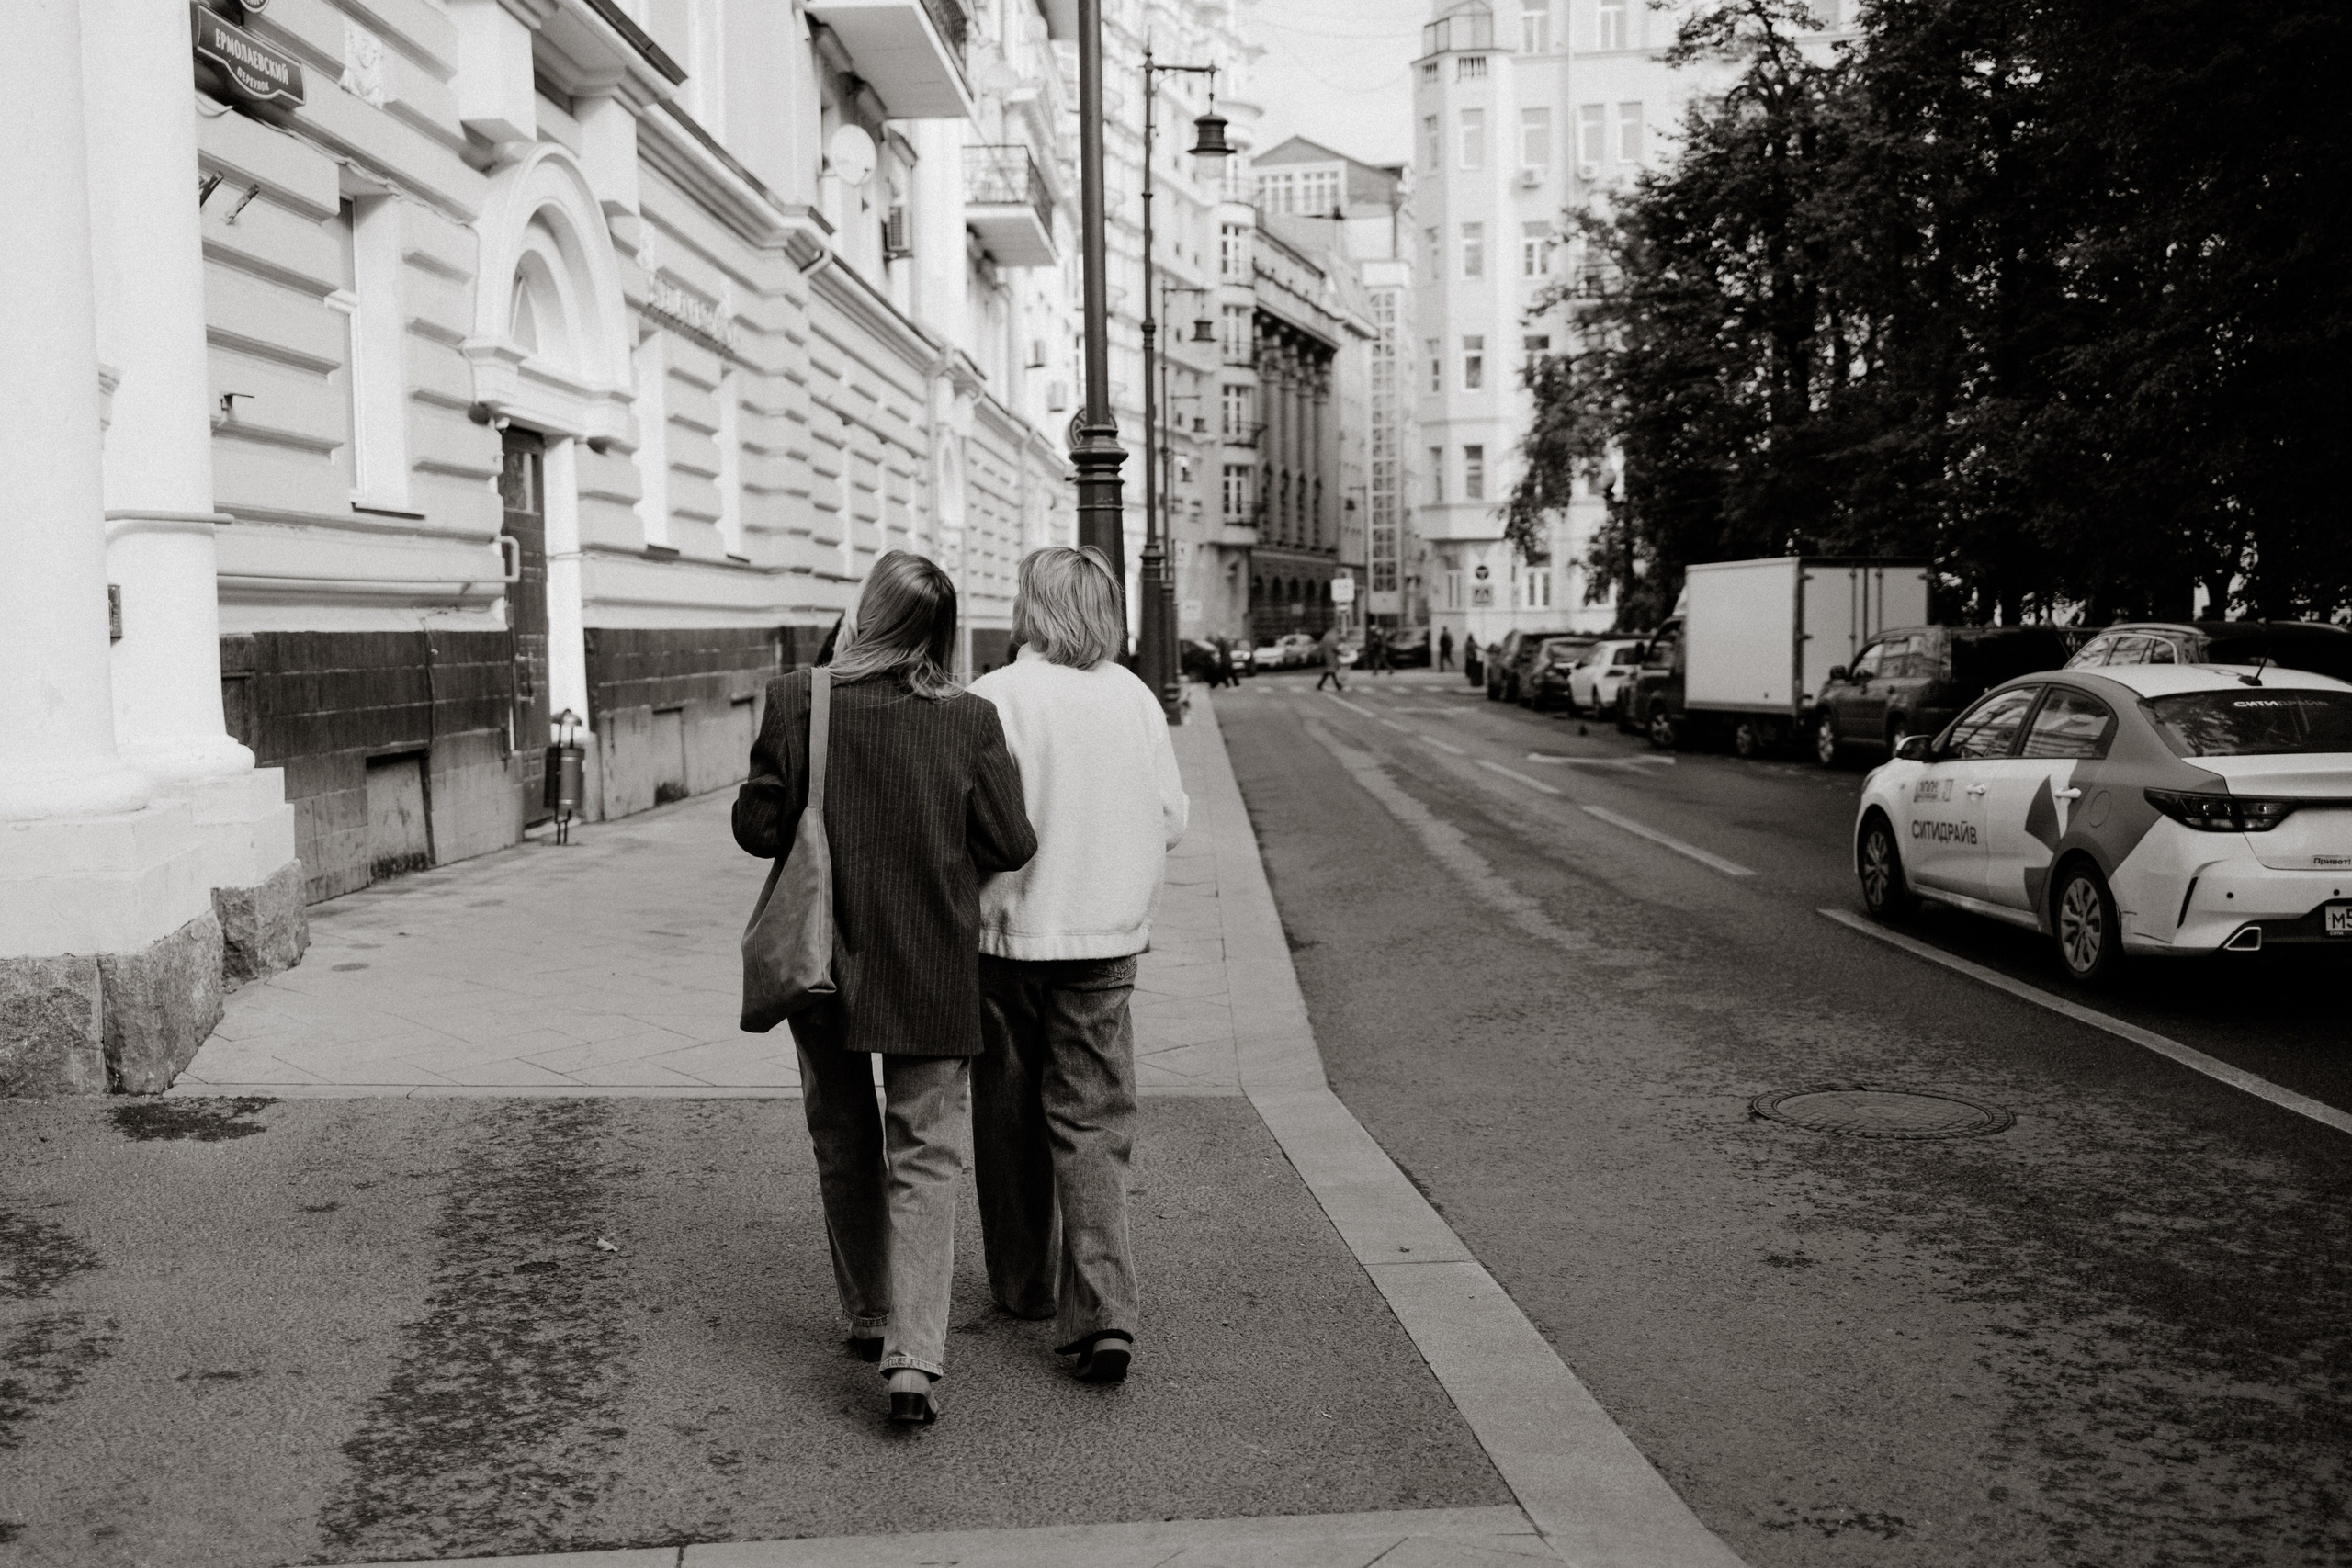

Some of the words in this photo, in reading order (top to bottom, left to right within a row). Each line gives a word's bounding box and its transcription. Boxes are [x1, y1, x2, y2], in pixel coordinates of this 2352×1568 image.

[215, 28, 289, 85] ЕРМОЛАЕВСКИЙ
[237, 66, 270, 92] ПЕРЕУЛОК
[1912, 819, 1977, 845] СИТИДРАЙВ
